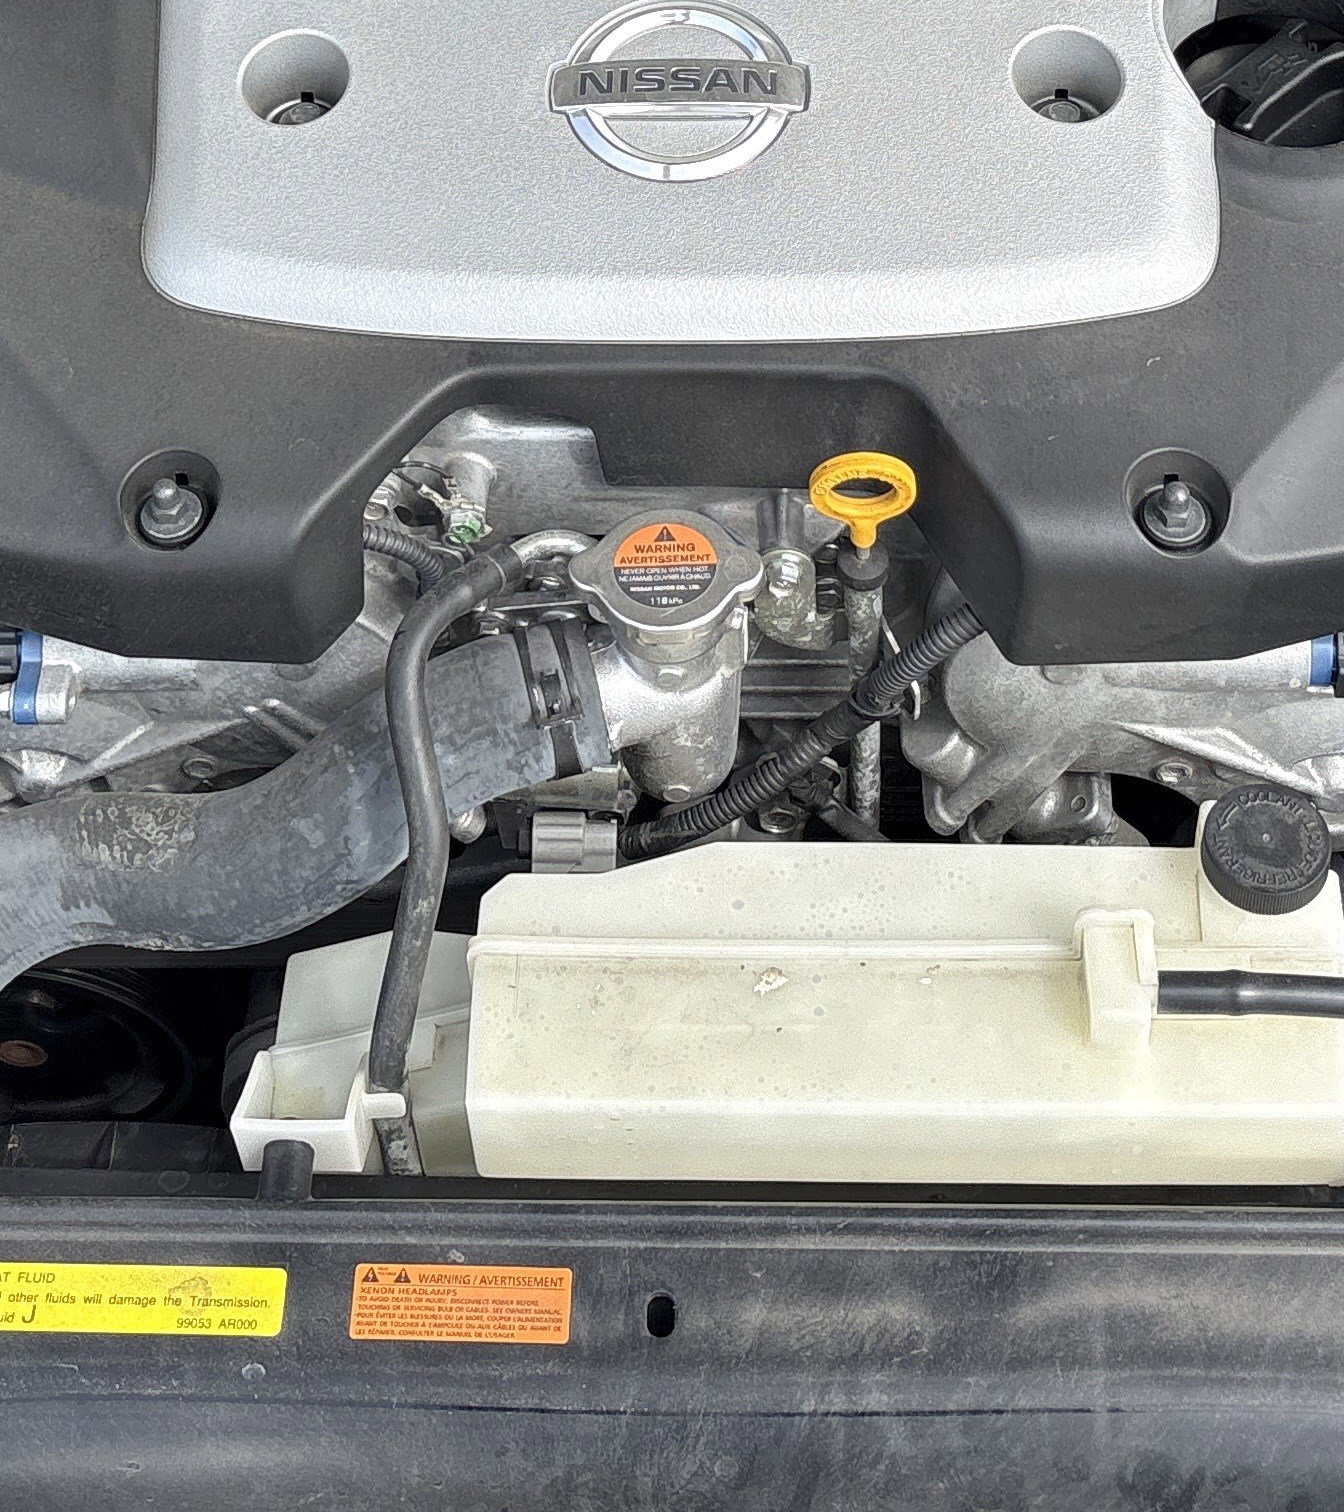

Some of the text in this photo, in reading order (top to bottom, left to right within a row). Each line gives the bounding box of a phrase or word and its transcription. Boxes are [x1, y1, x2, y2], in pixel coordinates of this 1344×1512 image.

[578, 66, 779, 96] NISSAN
[634, 543, 696, 554] WARNING
[619, 554, 712, 564] AVERTISSEMENT
[1238, 791, 1304, 816] COOLANT
[17, 1272, 55, 1284] FLUID
[418, 1273, 471, 1285] WARNING
[479, 1275, 565, 1287] AVERTISSEMENT
[398, 1288, 458, 1296] HEADLAMPS
[7, 1292, 40, 1303] other
[45, 1293, 76, 1304] fluids
[83, 1294, 103, 1305] will
[108, 1295, 157, 1308] damage
[163, 1295, 182, 1306] the
[190, 1296, 271, 1308] Transmission.
[21, 1304, 37, 1324] J
[175, 1317, 258, 1330] 99053 AR000
